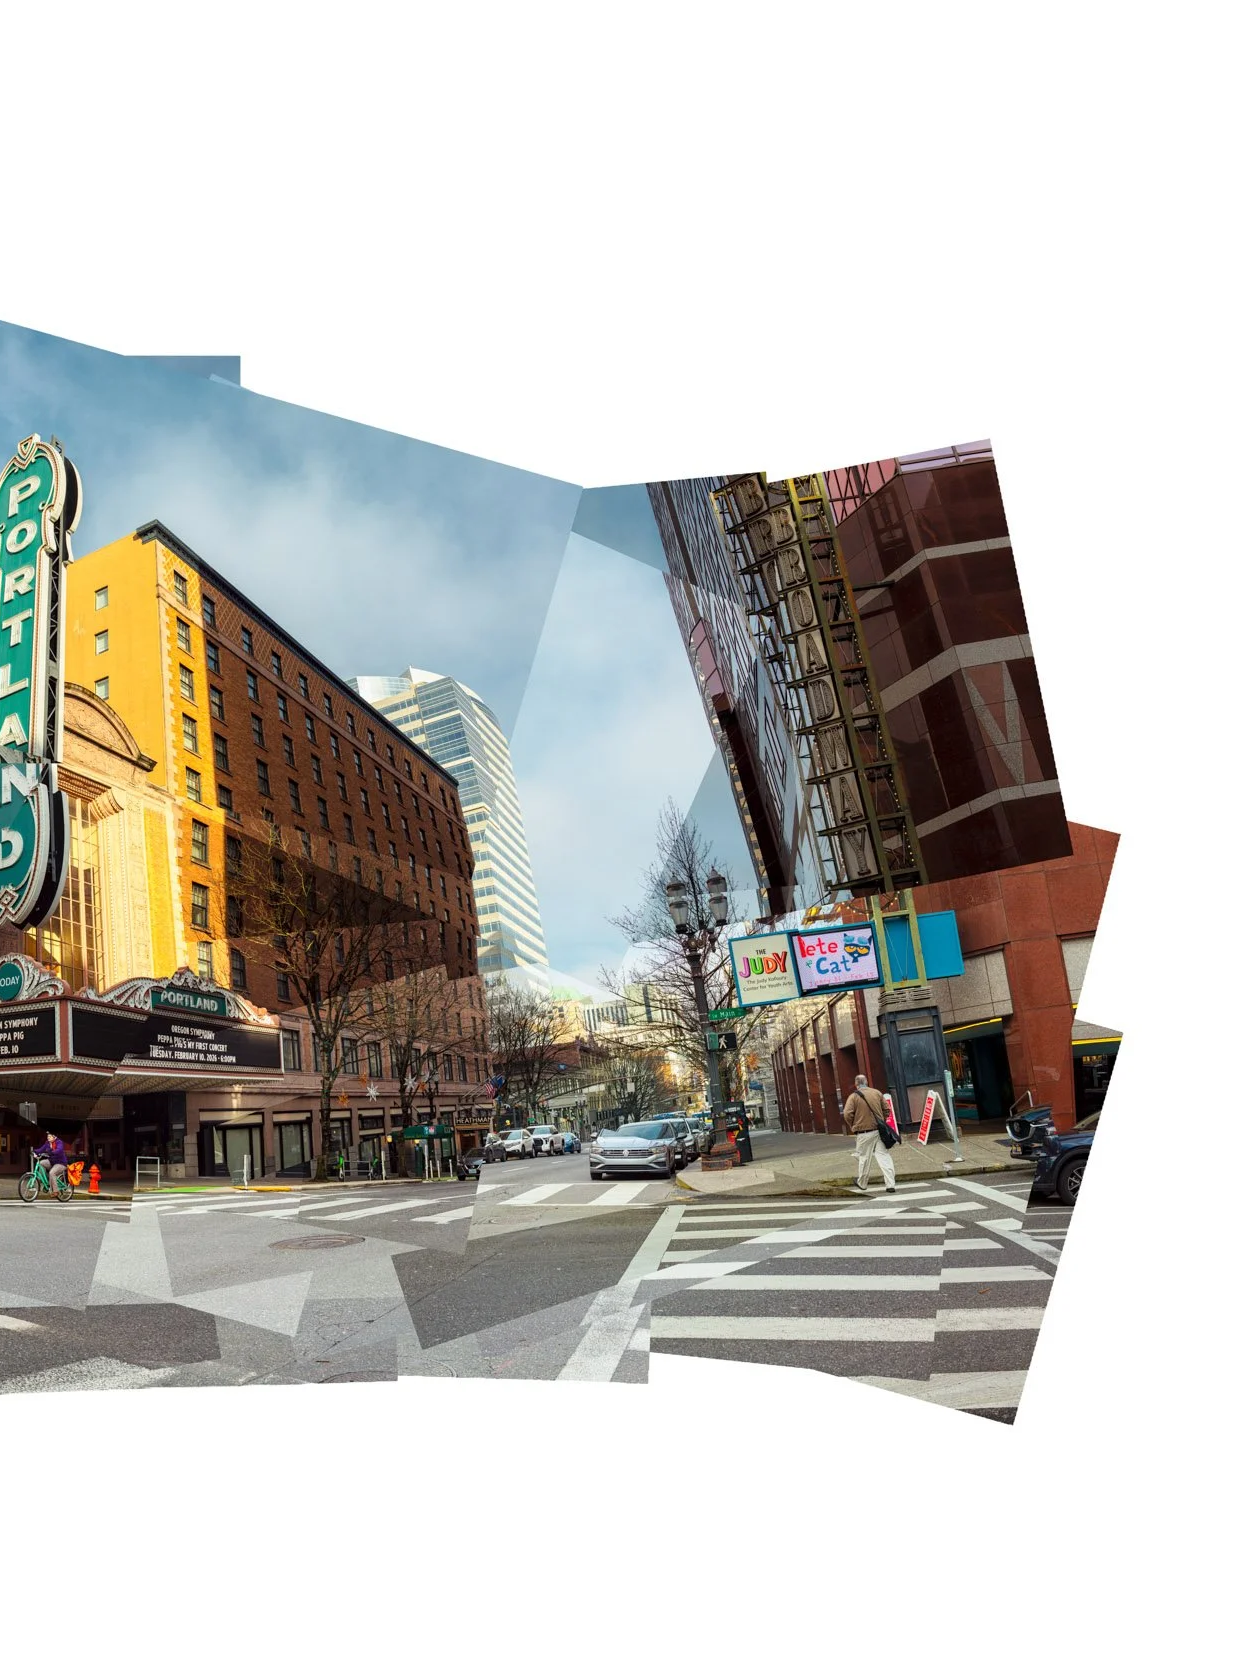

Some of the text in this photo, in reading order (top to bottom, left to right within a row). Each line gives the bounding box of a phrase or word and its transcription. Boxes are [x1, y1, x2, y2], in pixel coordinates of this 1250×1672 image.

[769, 506, 872, 877] BROADWAY
[739, 951, 787, 978] JUDY
[815, 954, 852, 975] Cat
[160, 990, 218, 1011] PORTLAND
[4, 1017, 38, 1030] SYMPHONY
[171, 1024, 190, 1035] OREGON
[13, 1031, 24, 1041] PIG
[157, 1034, 173, 1044] PEPPA
[195, 1042, 208, 1051] FIRST
[209, 1043, 228, 1052] CONCERT
[12, 1045, 19, 1054] 10
[174, 1051, 199, 1060] FEBRUARY
